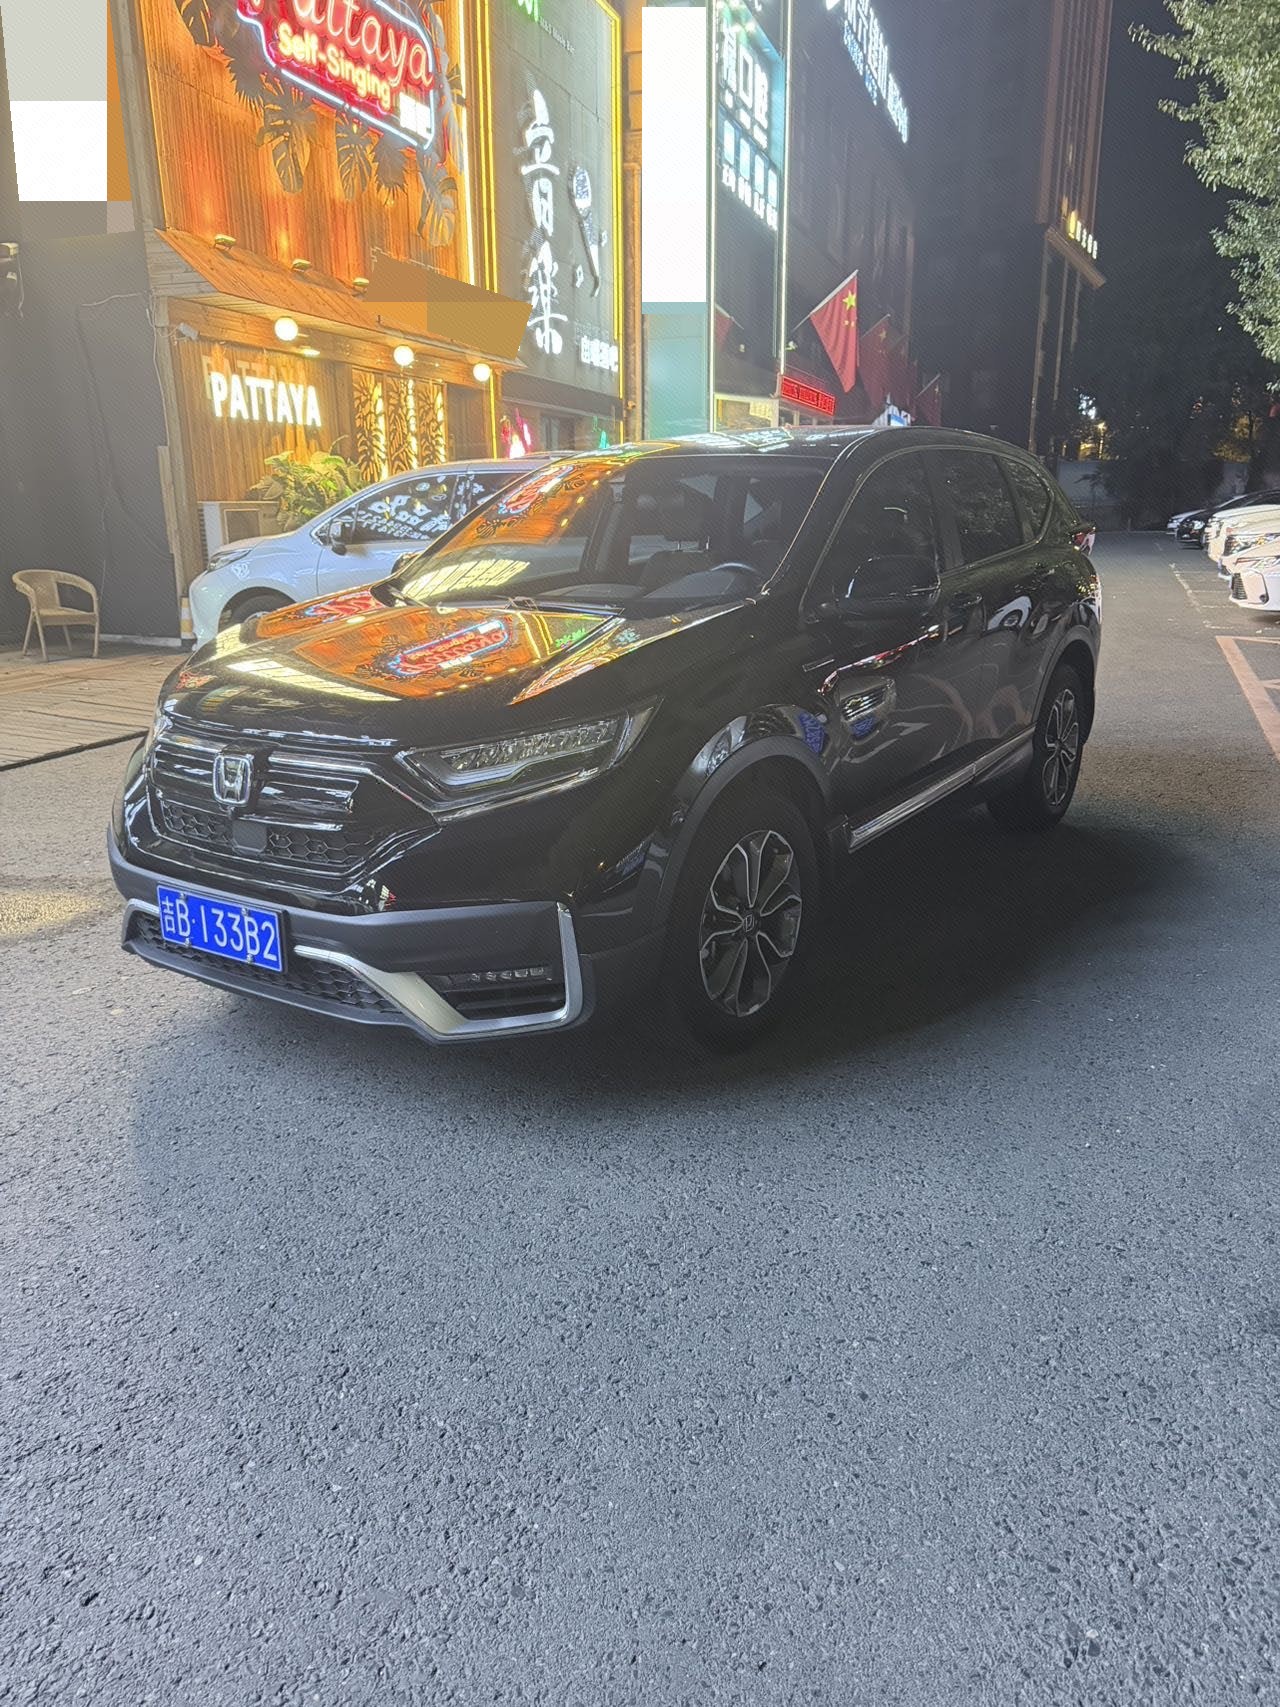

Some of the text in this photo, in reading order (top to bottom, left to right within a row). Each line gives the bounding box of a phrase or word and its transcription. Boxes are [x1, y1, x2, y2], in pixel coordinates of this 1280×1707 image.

[252, 0, 433, 87] attaya
[278, 20, 392, 112] Self-Singing
[210, 370, 322, 427] PATTAYA
